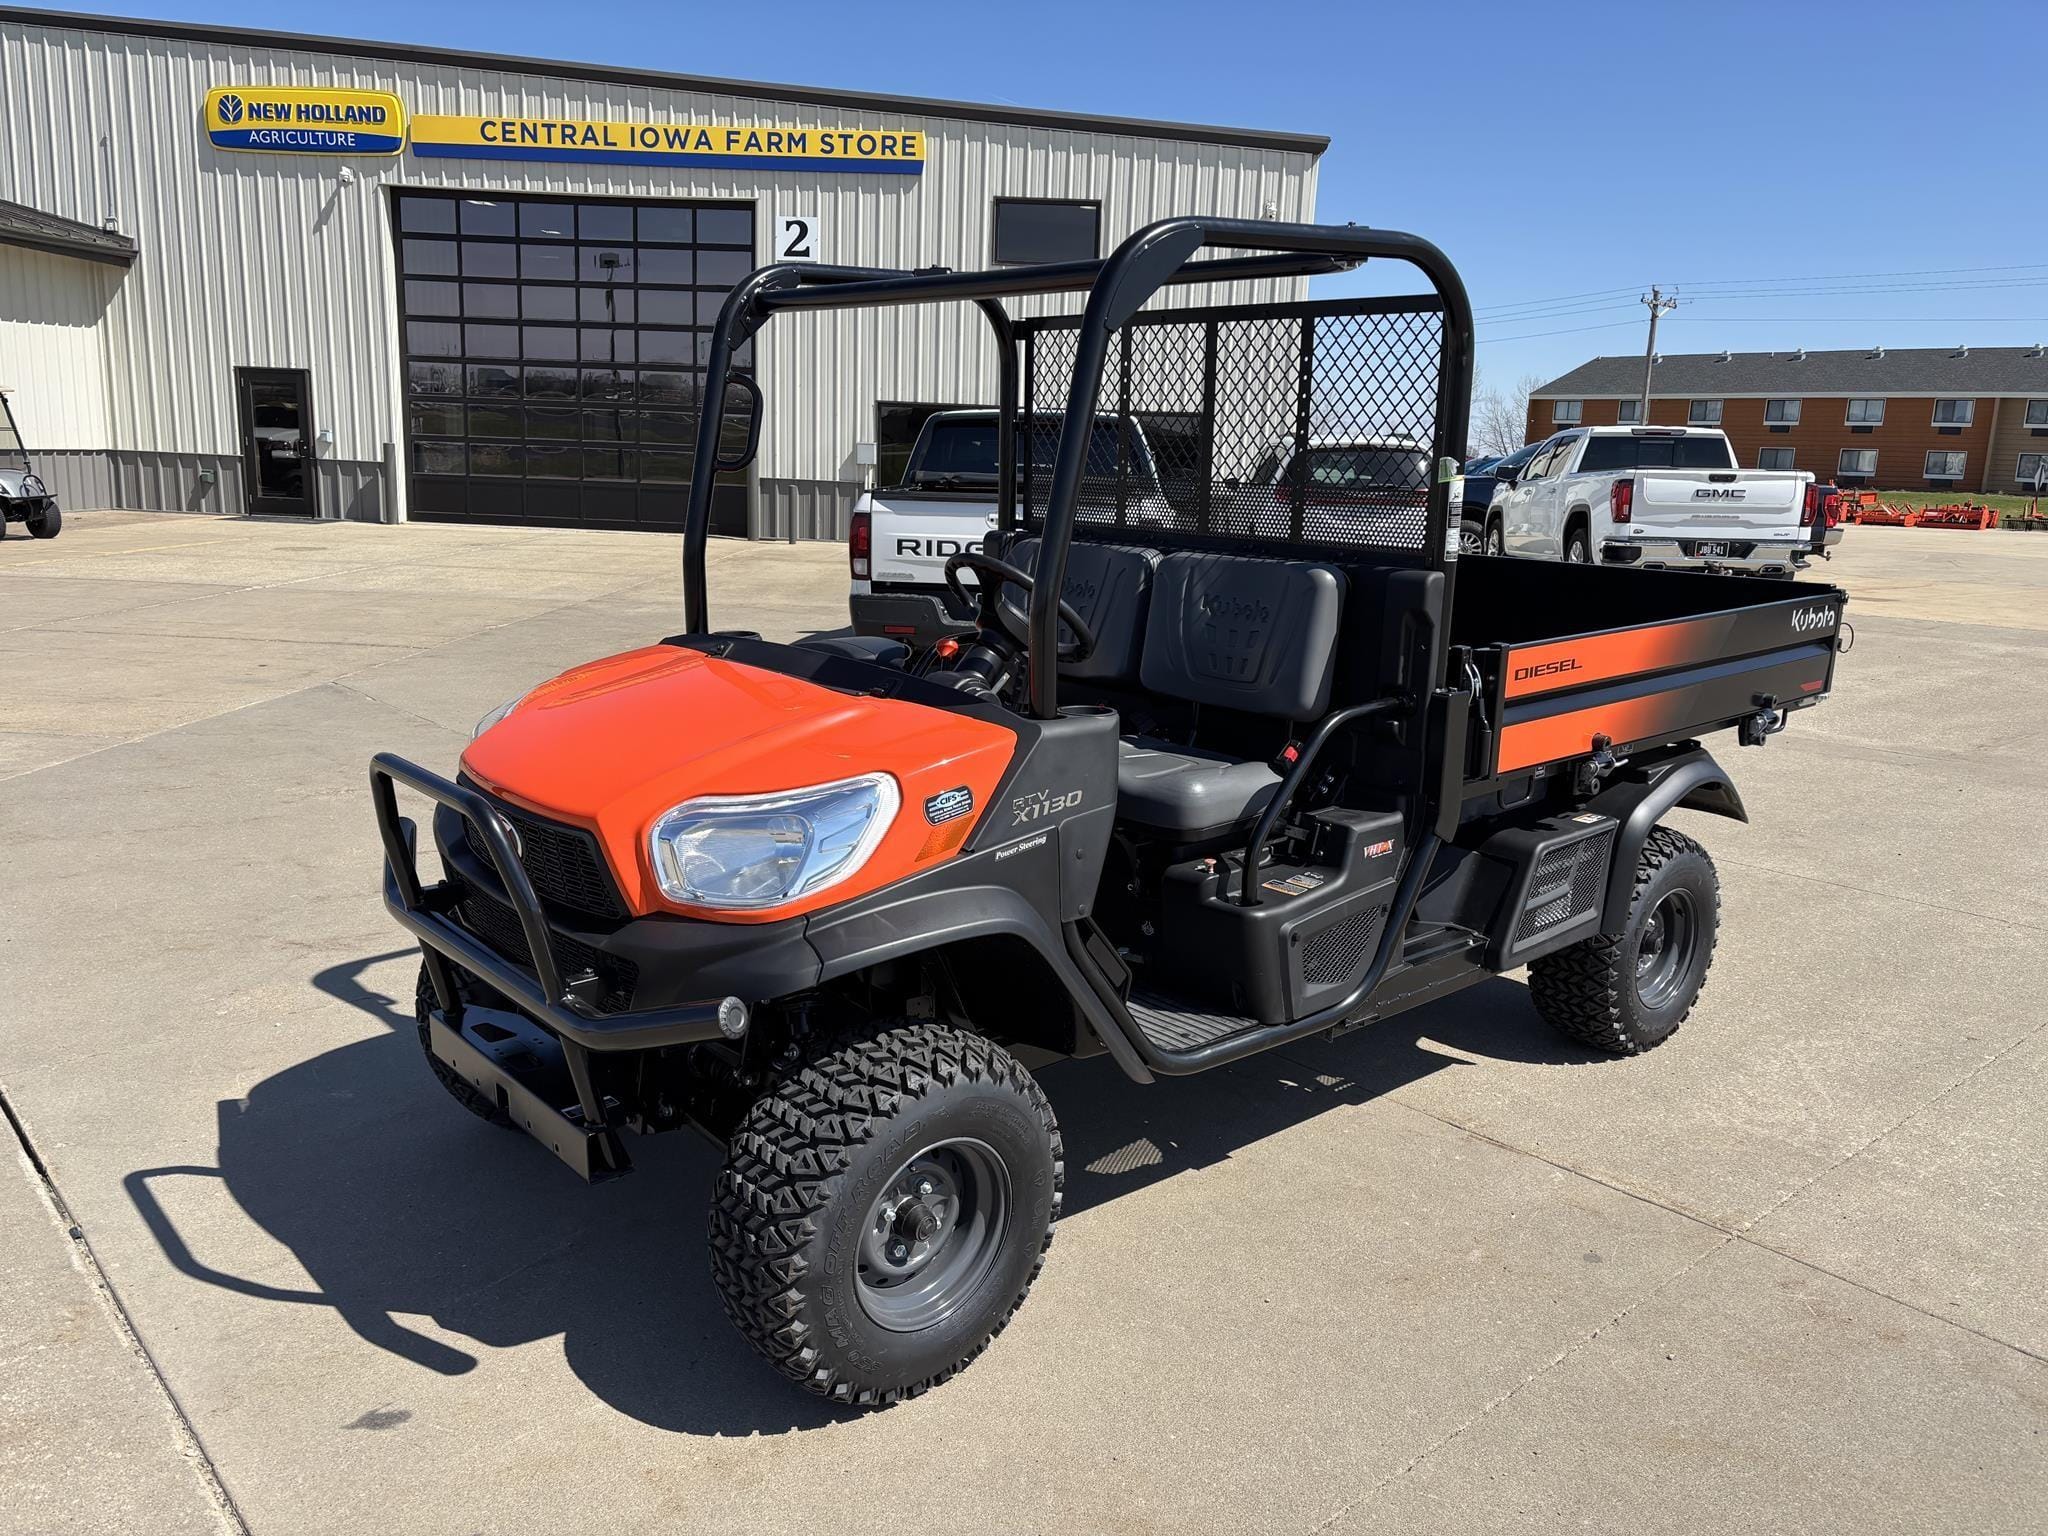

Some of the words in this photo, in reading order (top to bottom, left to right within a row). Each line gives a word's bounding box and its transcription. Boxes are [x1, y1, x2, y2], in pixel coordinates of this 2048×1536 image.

[247, 102, 292, 121] NEW
[299, 103, 386, 124] HOLLAND
[249, 130, 356, 147] AGRICULTURE
[479, 120, 618, 148] CENTRAL
[630, 126, 713, 152] IOWA
[725, 130, 807, 155] FARM
[819, 133, 917, 157] STORE
[783, 219, 811, 258] 2
[1695, 488, 1747, 498] GMC
[1791, 605, 1835, 632] Kubota
[1514, 658, 1584, 682] DIESEL
[940, 793, 958, 805] CIFS
[1011, 790, 1083, 827] X1130
[1012, 789, 1049, 809] RTV
[995, 847, 1018, 860] Power
[1018, 836, 1047, 851] Steering
